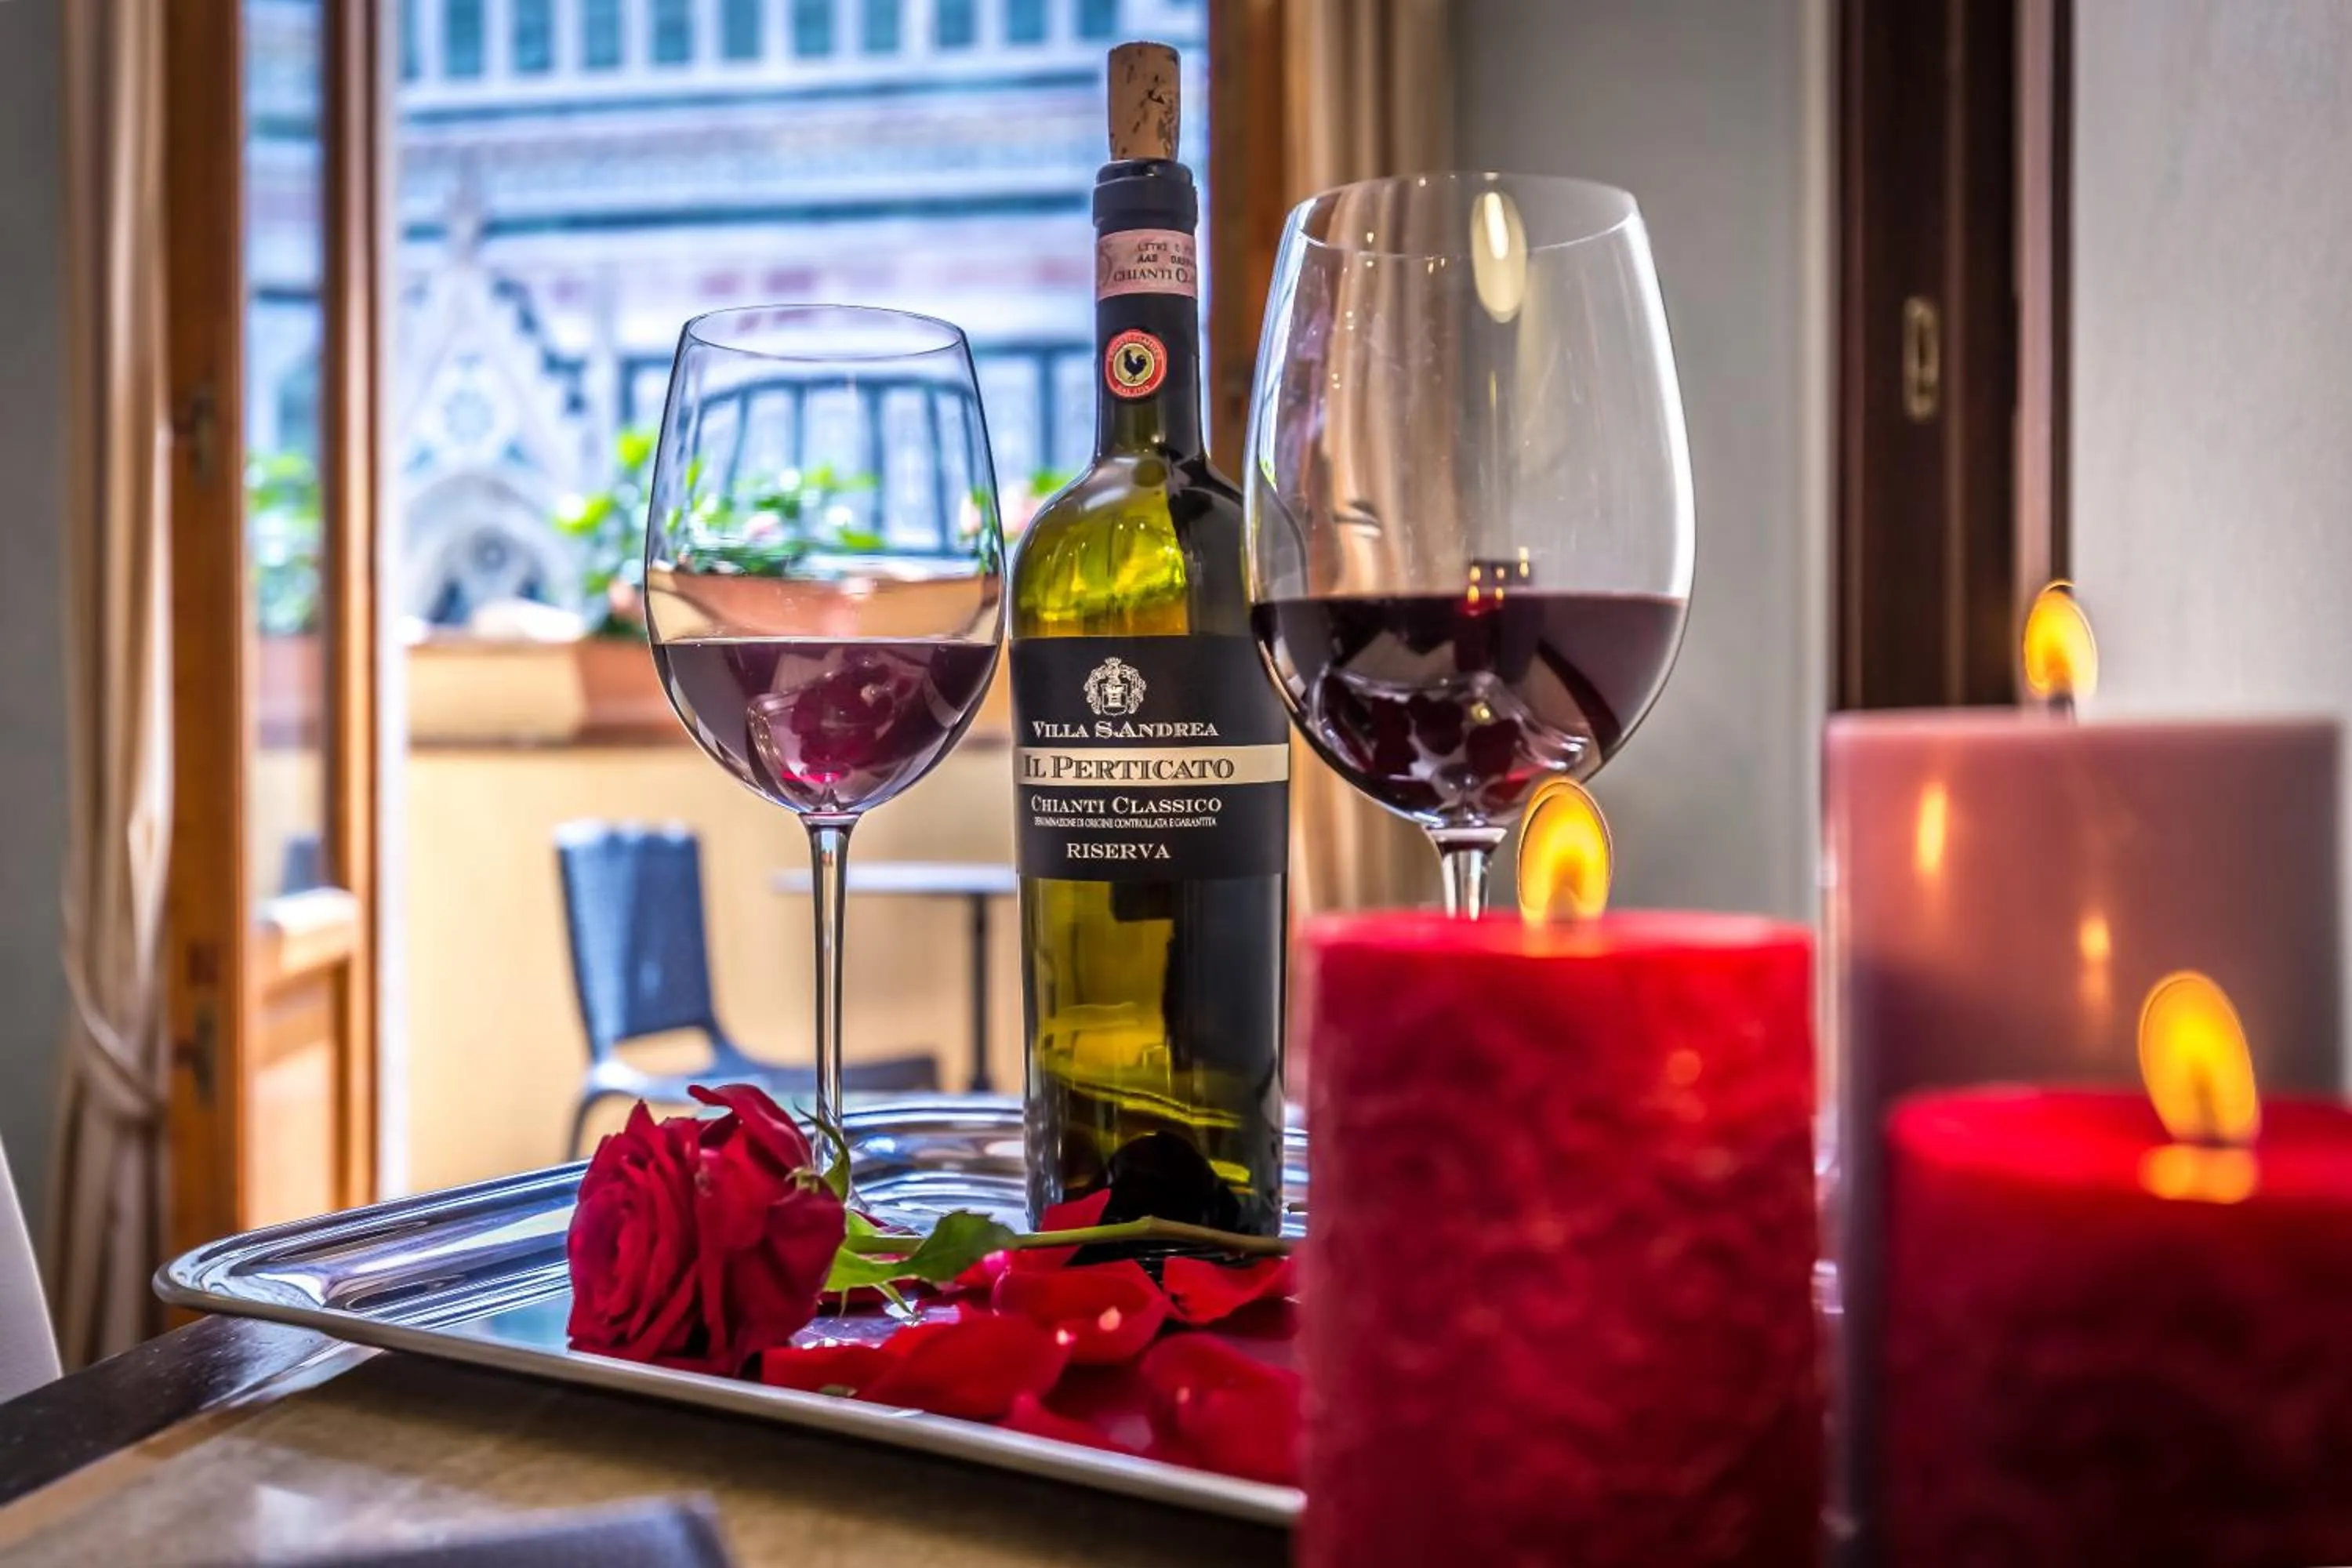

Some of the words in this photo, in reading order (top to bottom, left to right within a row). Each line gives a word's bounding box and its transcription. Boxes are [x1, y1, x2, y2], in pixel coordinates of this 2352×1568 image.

[1113, 268, 1172, 282] CHIANTI
[1032, 721, 1089, 739] VILLA
[1024, 754, 1047, 779] IL
[1051, 755, 1235, 780] PERTICATO
[1031, 794, 1105, 813] CHIANTI
[1112, 796, 1222, 815] CLASSICO
[1066, 843, 1171, 860] RISERVA
